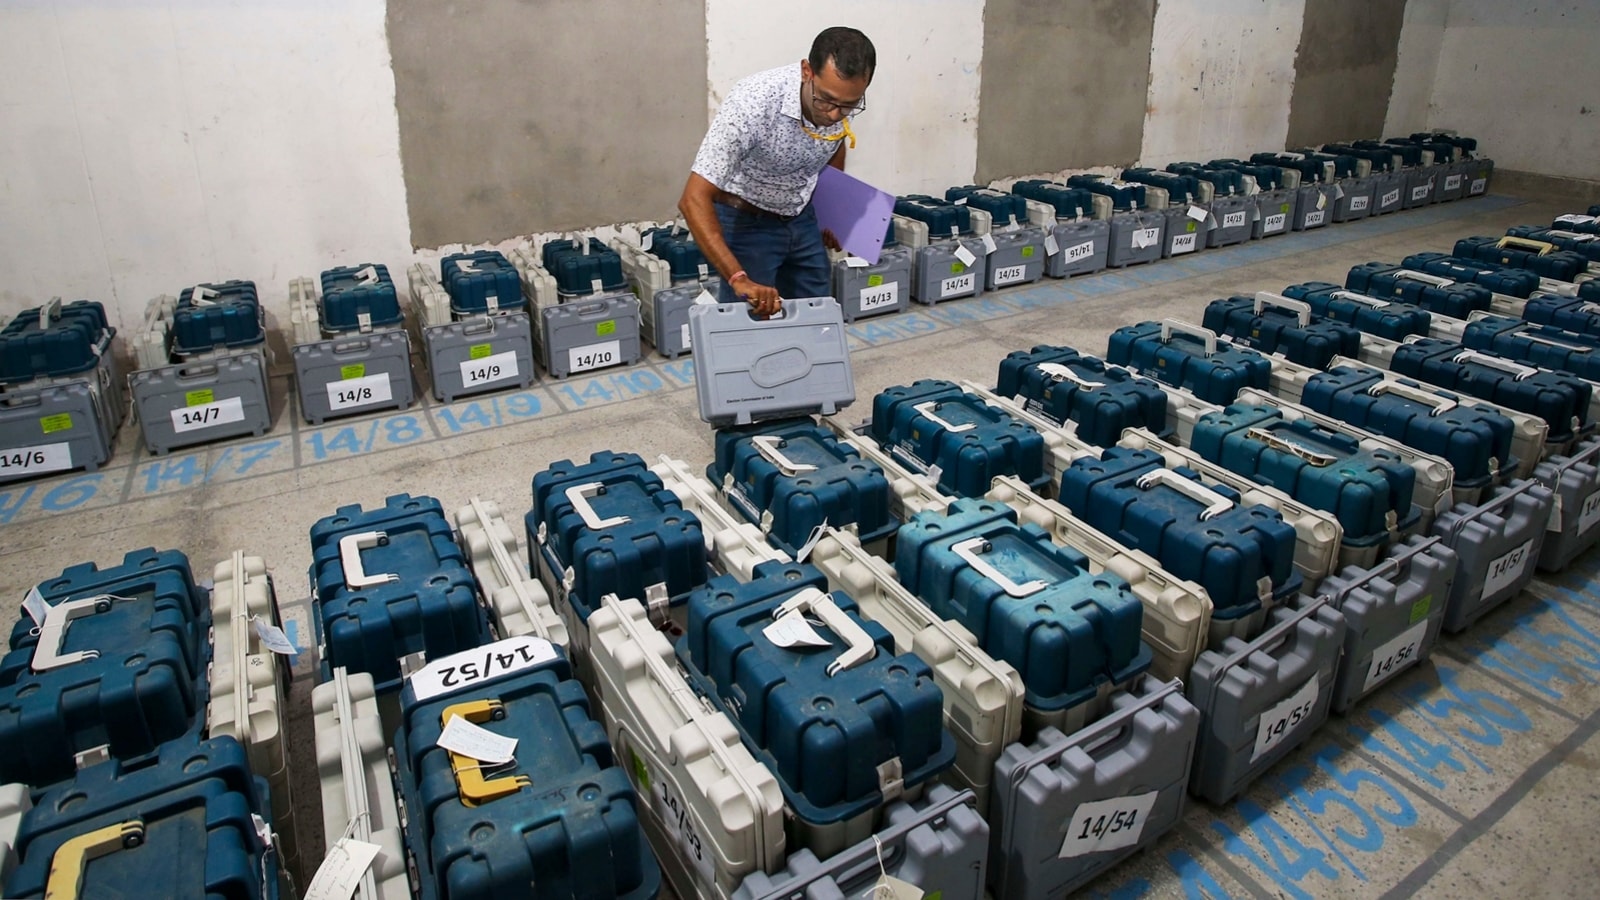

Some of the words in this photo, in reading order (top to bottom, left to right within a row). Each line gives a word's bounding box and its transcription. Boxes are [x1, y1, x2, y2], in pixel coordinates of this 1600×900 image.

[1226, 214, 1242, 223] 14/19
[1267, 216, 1283, 225] 14/20
[1307, 214, 1321, 223] 14/21
[1069, 243, 1090, 258] 14/16
[945, 278, 969, 291] 14/14
[998, 268, 1021, 280] 14/15
[865, 291, 892, 306] 14/13
[576, 351, 612, 367] 14/10
[469, 364, 501, 382] 14/9
[337, 387, 373, 404] 14/8
[559, 370, 663, 407] 14/10
[181, 407, 220, 425] 14/7
[437, 393, 543, 433] 14/9
[306, 415, 424, 460] 14/8
[0, 450, 45, 468] 14/6
[141, 440, 281, 493] 14/7
[0, 473, 105, 524] /6
[1491, 548, 1525, 579] 14/57
[437, 644, 536, 688] 14/52
[1374, 642, 1414, 678] 14/56
[1266, 700, 1312, 744] 14/55
[661, 782, 702, 861] 14/53
[1077, 809, 1138, 840] 14/54
[1211, 745, 1419, 900] 14/55
